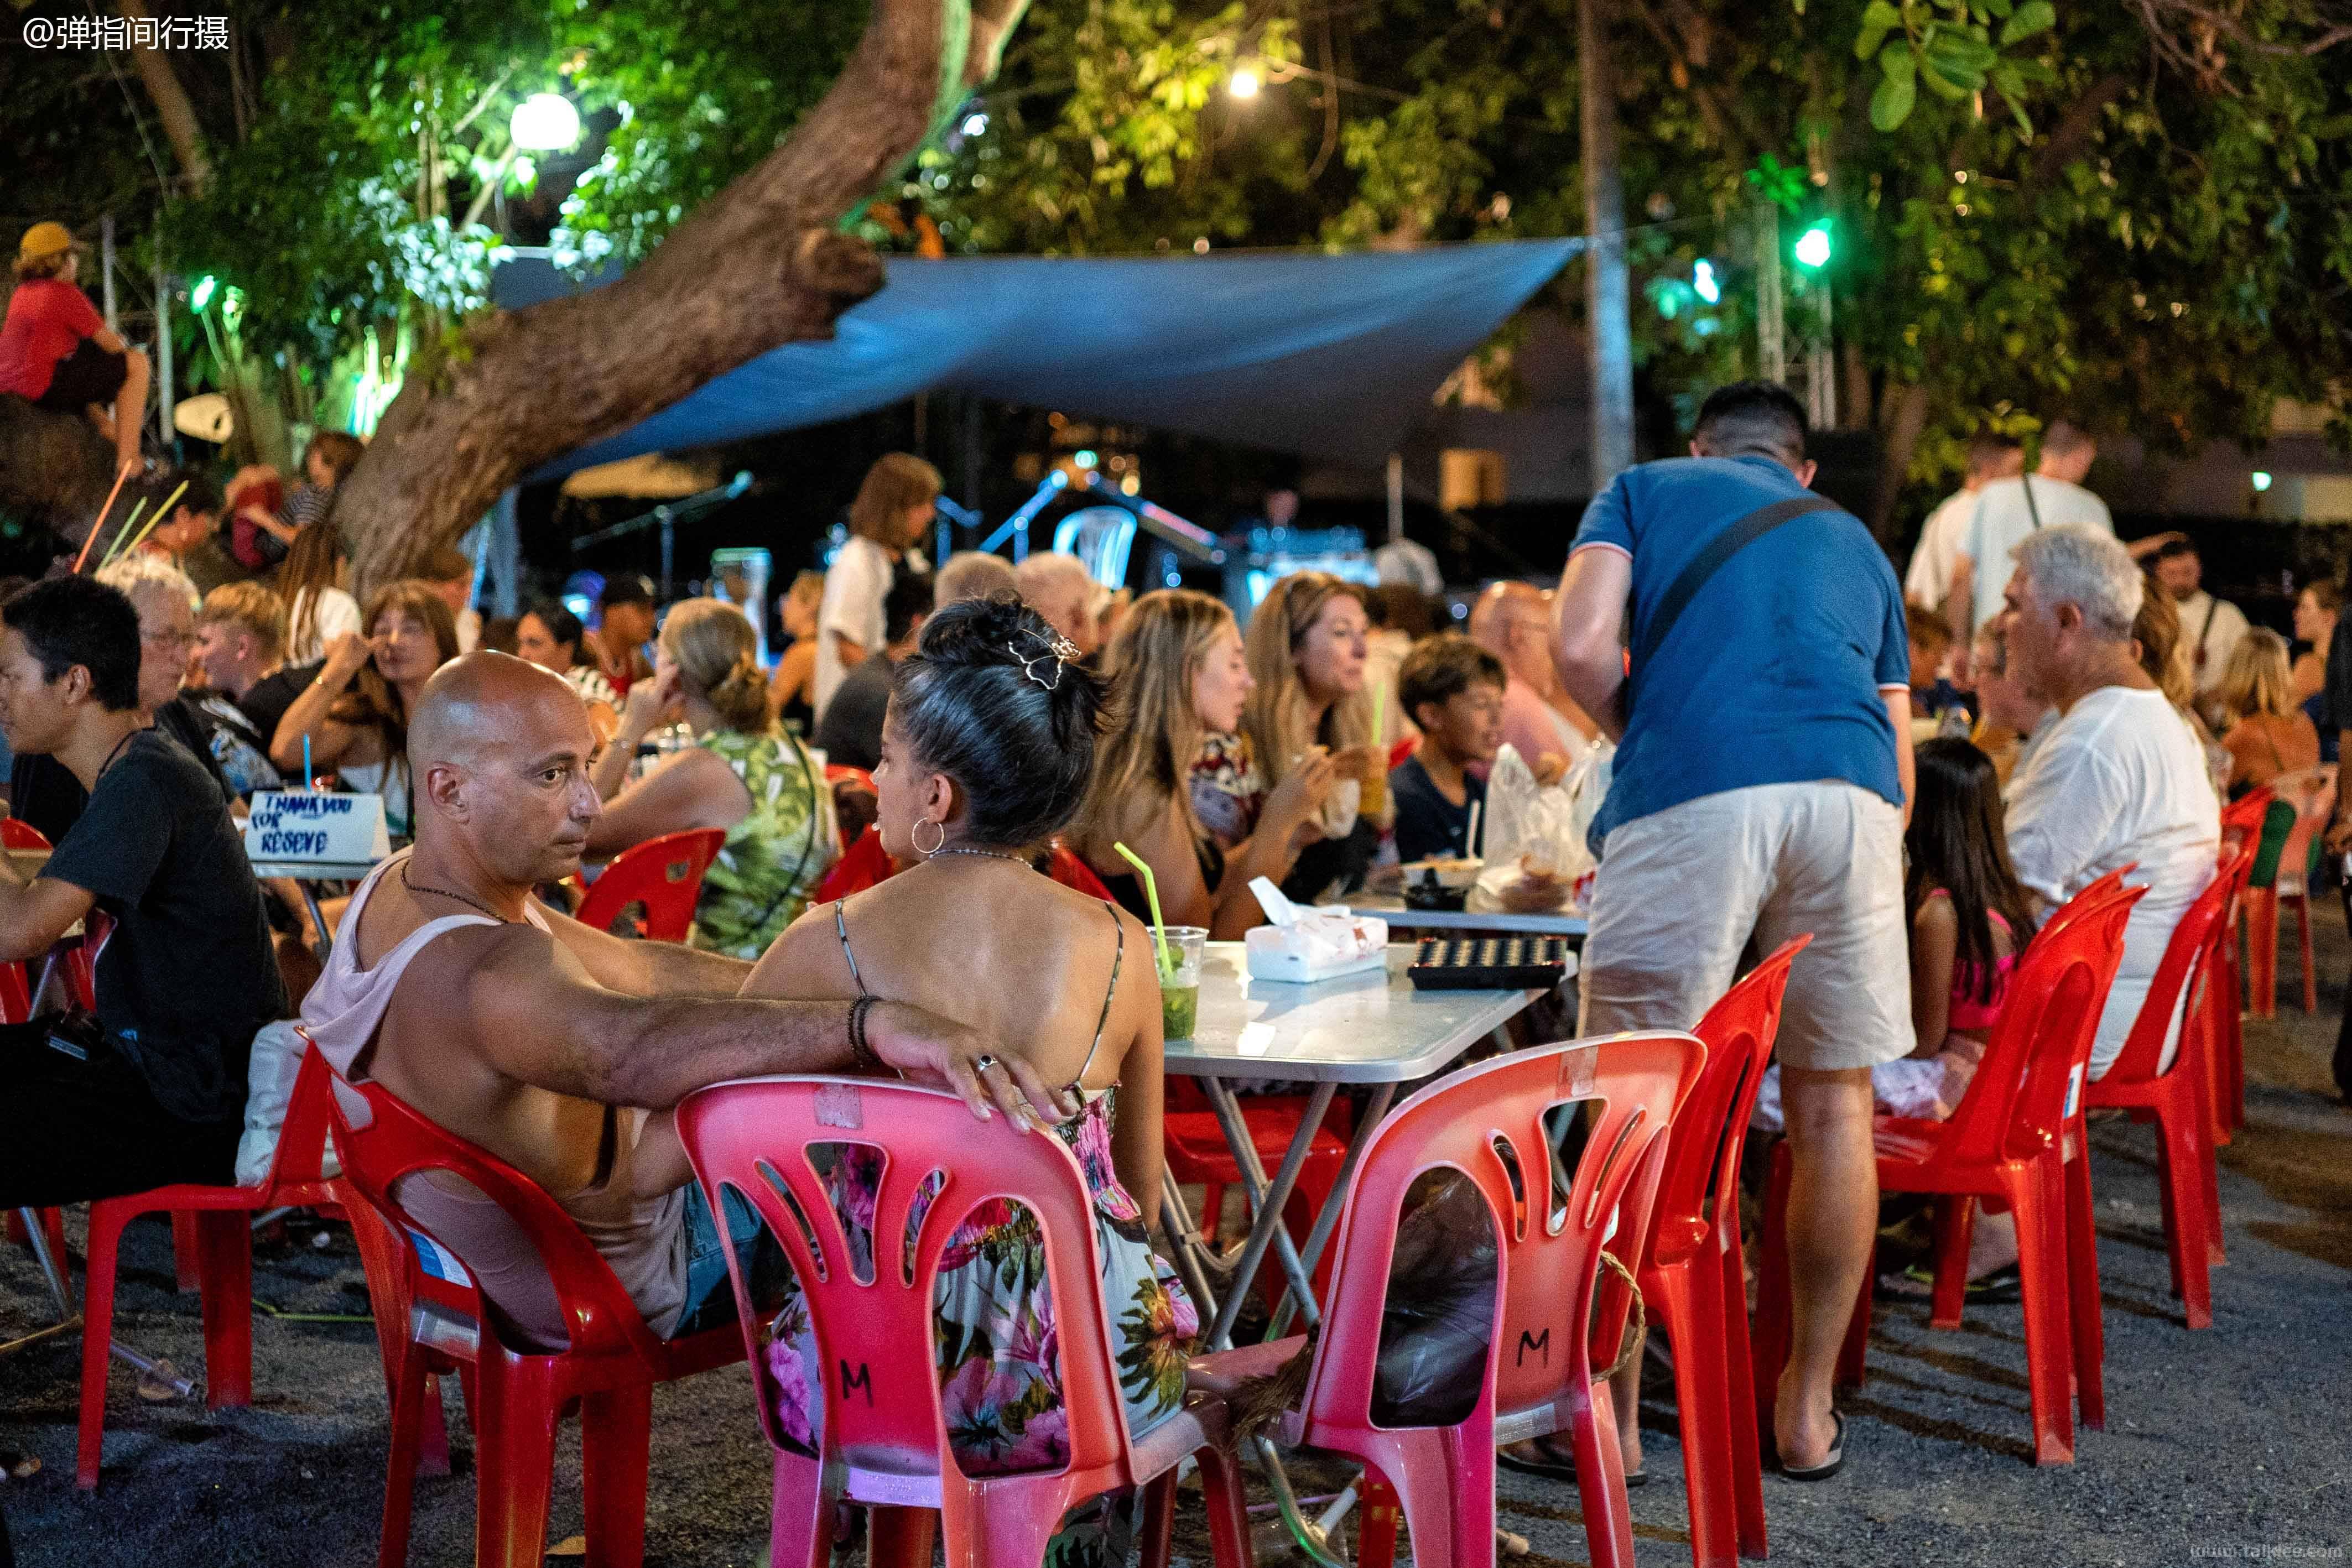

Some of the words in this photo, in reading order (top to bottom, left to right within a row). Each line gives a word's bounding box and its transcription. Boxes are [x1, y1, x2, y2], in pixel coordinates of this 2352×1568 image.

[263, 792, 319, 815] THANK
[322, 796, 353, 814] YOU
[1517, 1329, 1549, 1369] M
[840, 1359, 873, 1408] M
